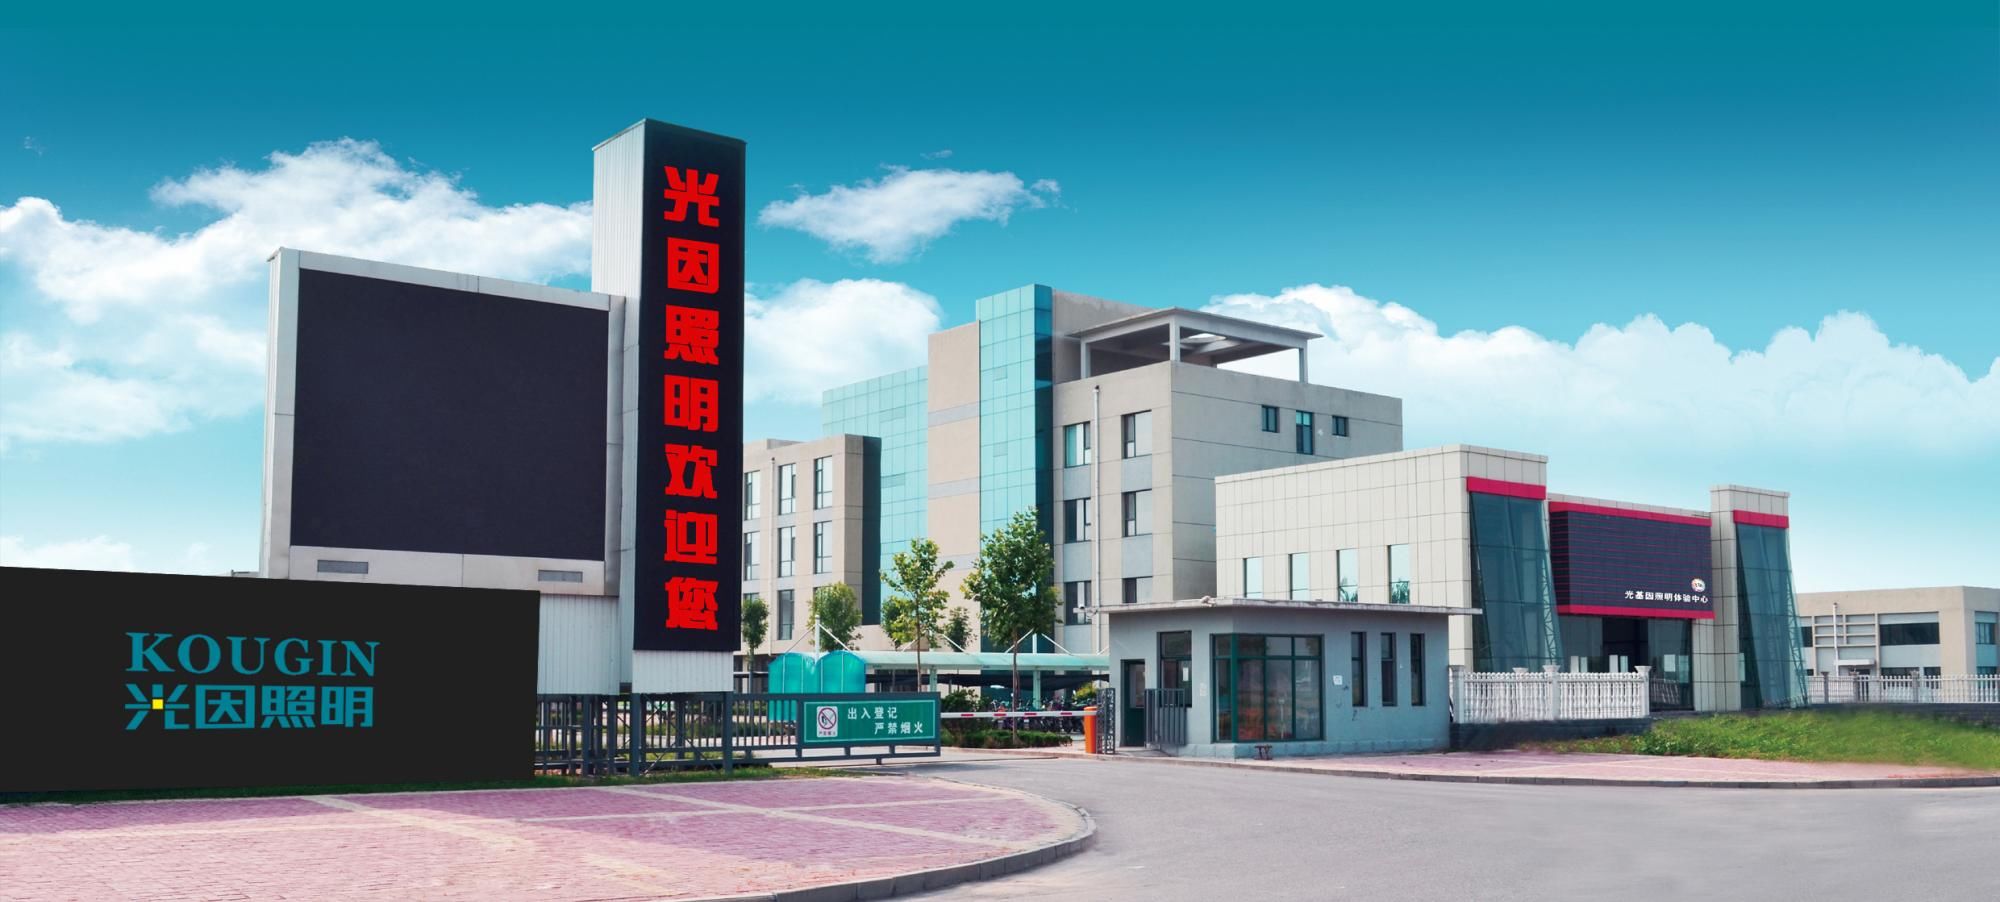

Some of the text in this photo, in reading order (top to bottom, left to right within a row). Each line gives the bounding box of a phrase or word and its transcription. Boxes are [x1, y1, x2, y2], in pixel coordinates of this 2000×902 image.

[663, 165, 720, 631] 光因照明欢迎您
[125, 632, 380, 676] KOUGIN
[125, 683, 374, 730] 光因照明
[847, 706, 897, 720] 出入登记
[874, 721, 923, 735] 严禁烟火
